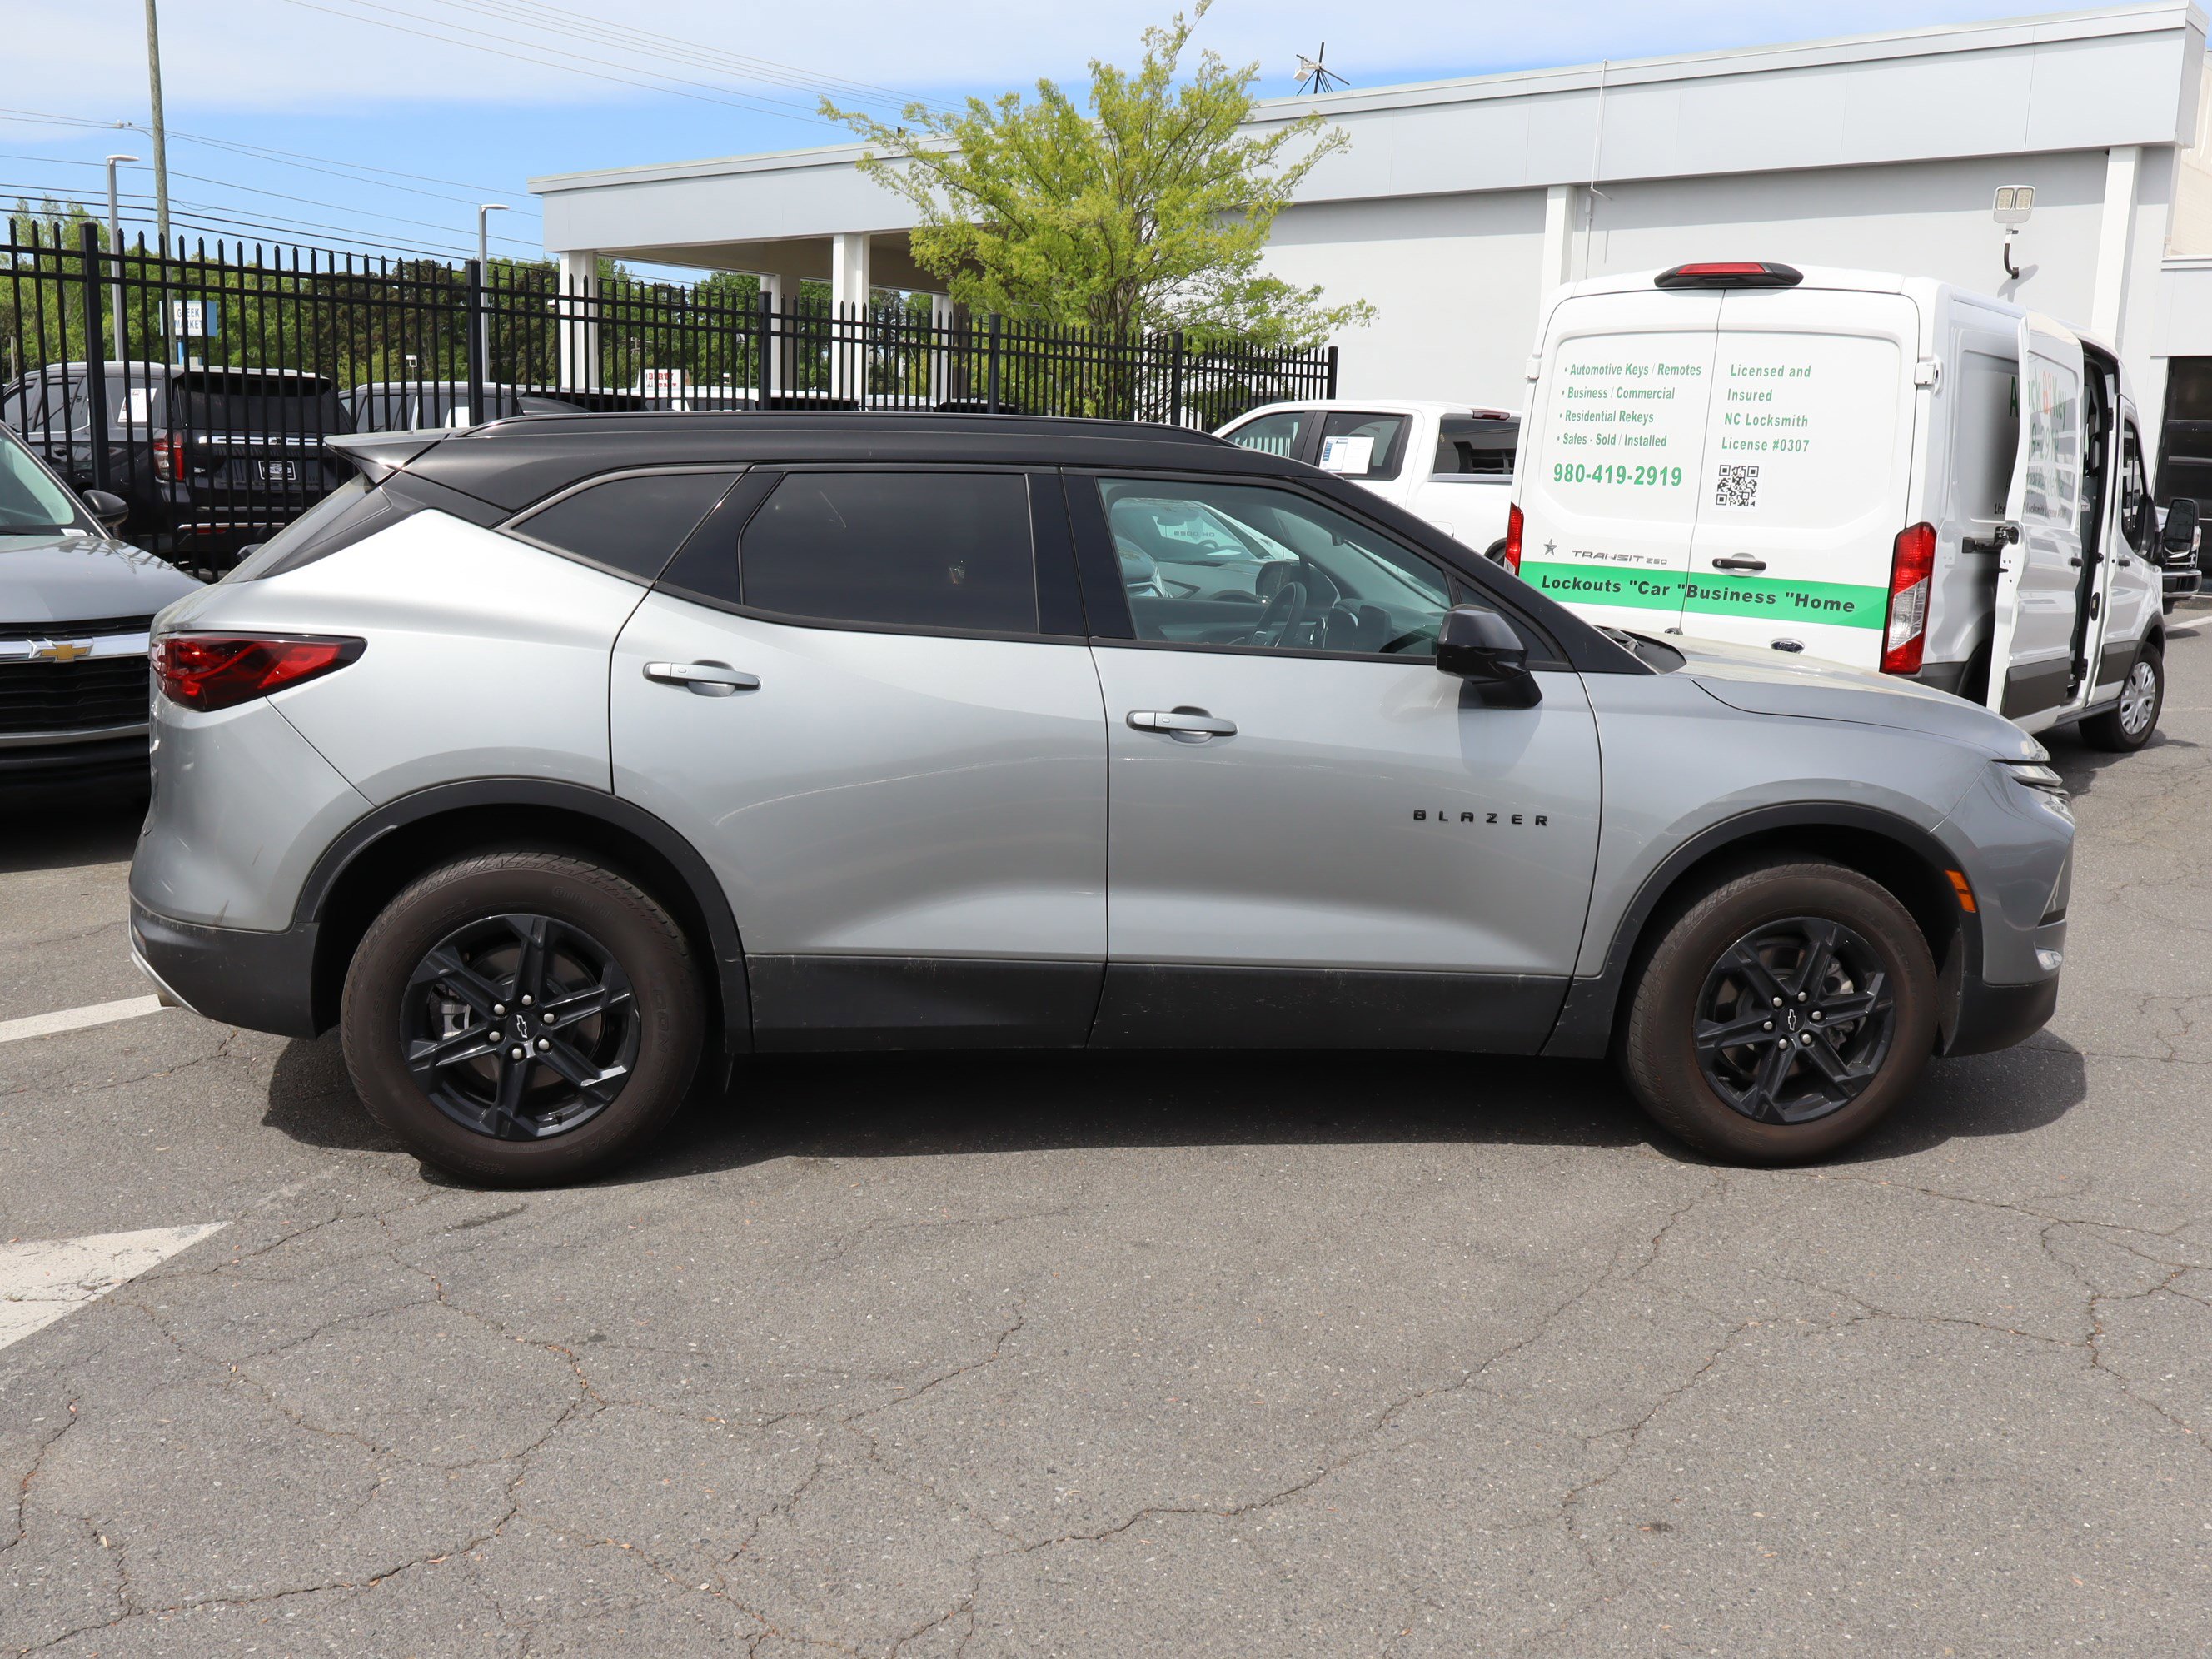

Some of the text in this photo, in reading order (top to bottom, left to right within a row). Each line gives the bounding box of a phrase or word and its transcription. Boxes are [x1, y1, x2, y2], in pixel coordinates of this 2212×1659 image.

[177, 308, 200, 318] GEEK
[1570, 363, 1622, 375] Automotive
[1625, 363, 1649, 378] Keys
[1657, 363, 1701, 376] Remotes
[1731, 364, 1811, 378] Licensed and
[1567, 386, 1608, 398] Business
[1617, 386, 1676, 400] Commercial
[1727, 388, 1772, 401] Insured
[1565, 410, 1654, 426] Residential Rekeys
[1724, 413, 1809, 427] NC Locksmith
[1562, 433, 1587, 445] Safes
[1596, 433, 1617, 445] Sold
[1624, 434, 1667, 446] Installed
[1722, 436, 1810, 452] License #0307
[1554, 463, 1682, 486] 980-419-2919
[1572, 550, 1644, 563] TRANSIT
[1542, 575, 1855, 613] Lockouts "Car "Business "Home
[1413, 810, 1548, 826] BLAZER
